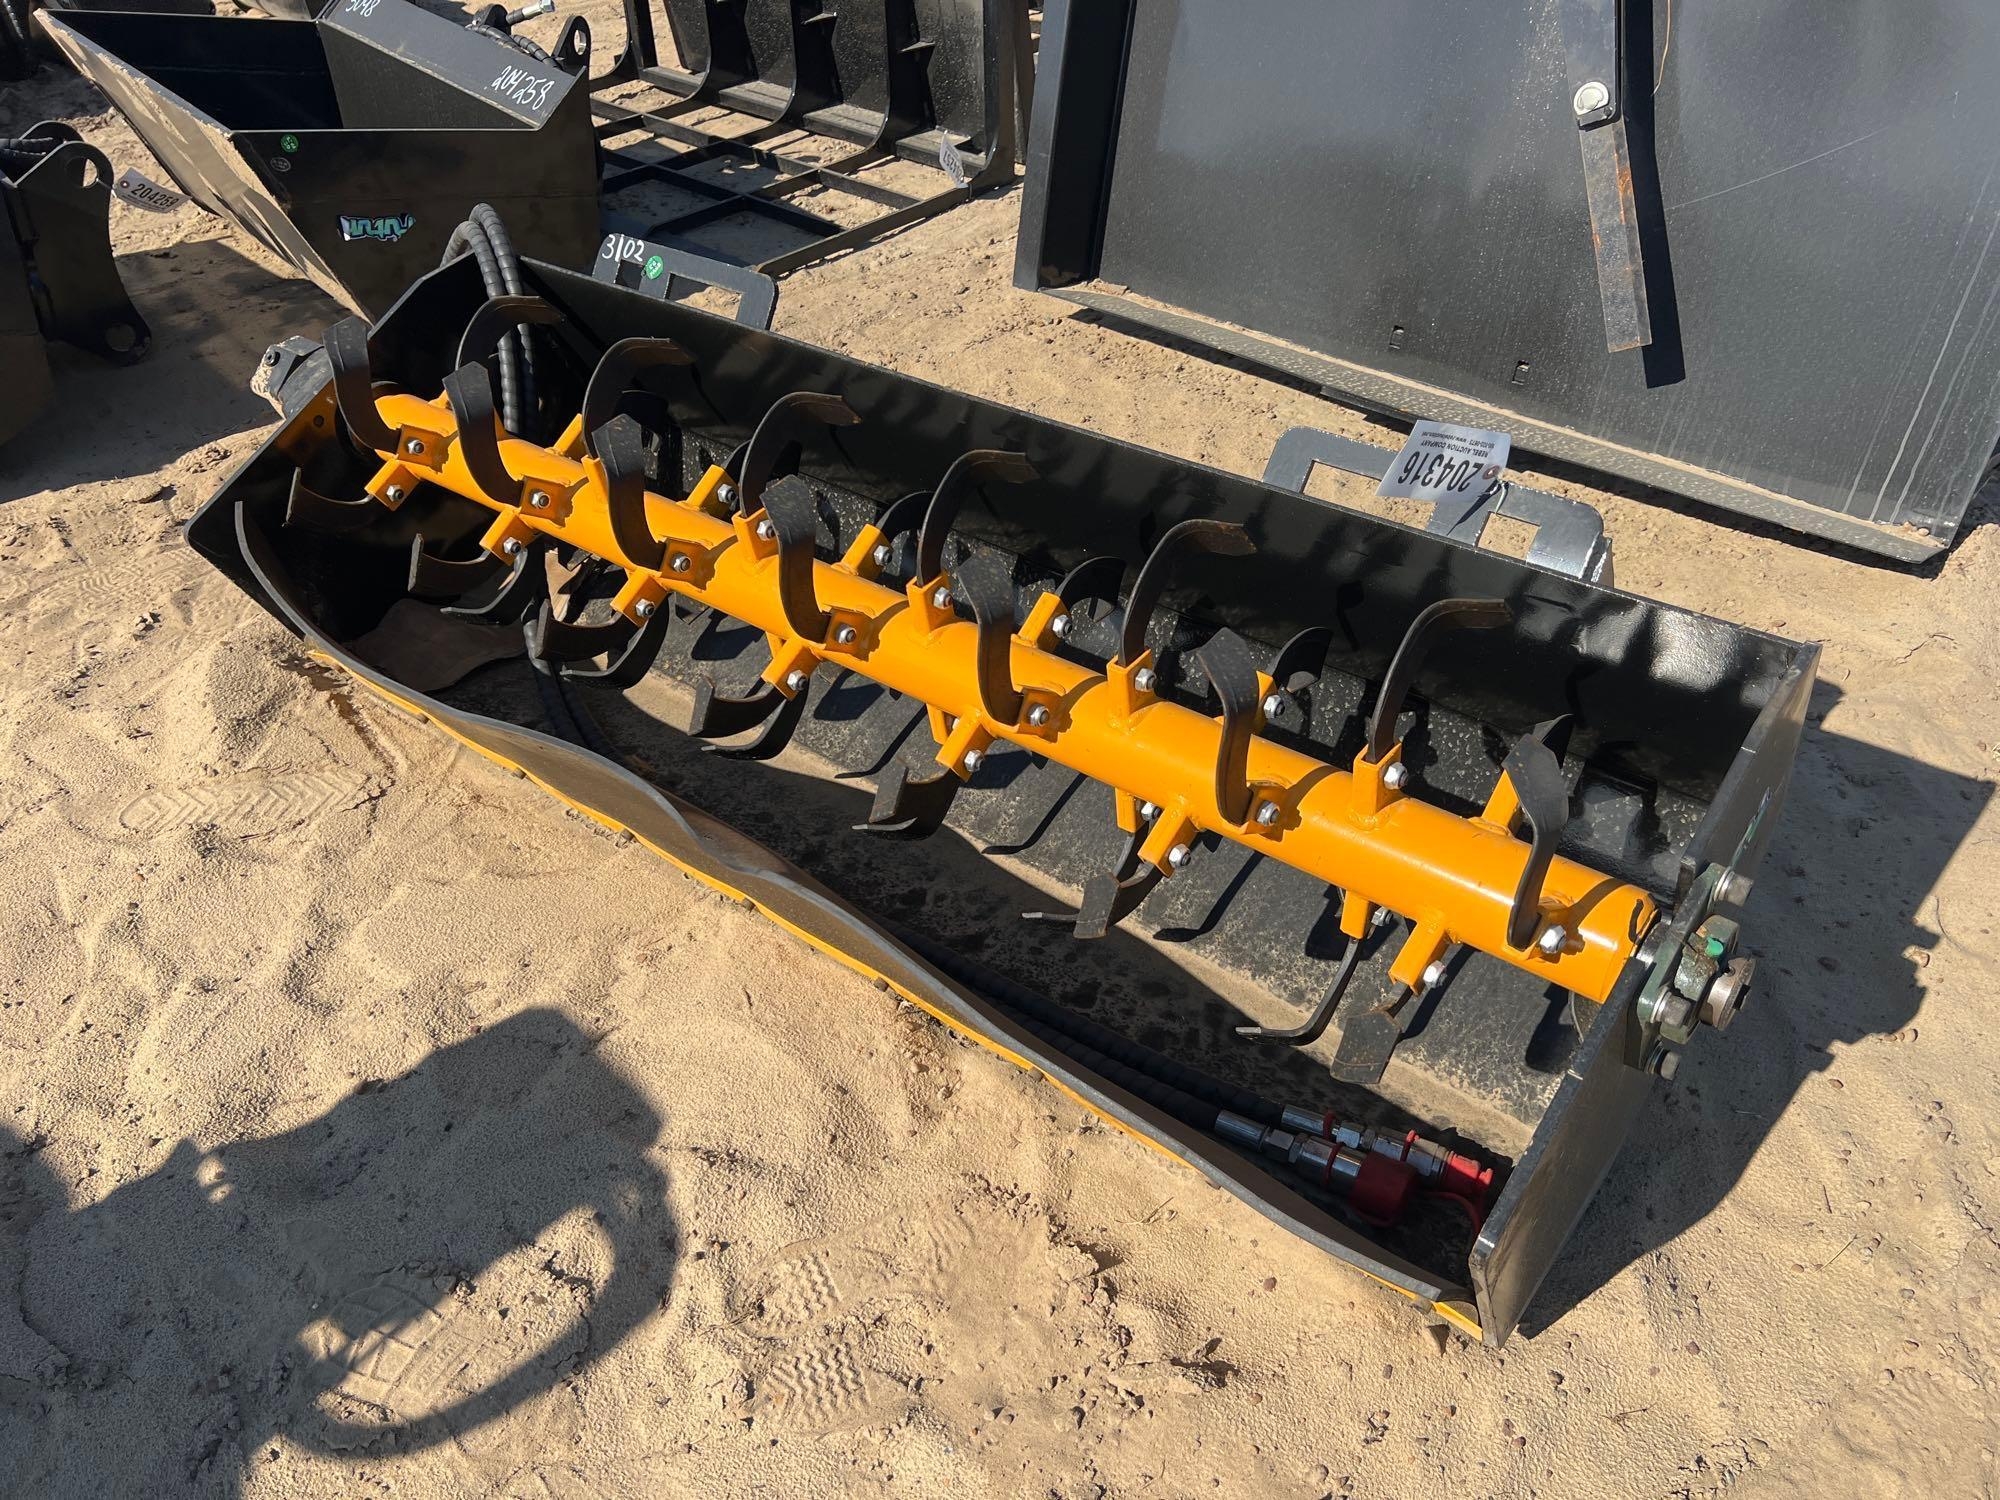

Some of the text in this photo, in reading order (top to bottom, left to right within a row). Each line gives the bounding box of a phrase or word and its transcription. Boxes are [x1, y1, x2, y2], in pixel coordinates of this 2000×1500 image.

[491, 65, 555, 111] 204258
[601, 234, 645, 262] 3102
[1421, 440, 1489, 458] REBEL AUCTION COMPANY
[1398, 451, 1485, 493] 204316
